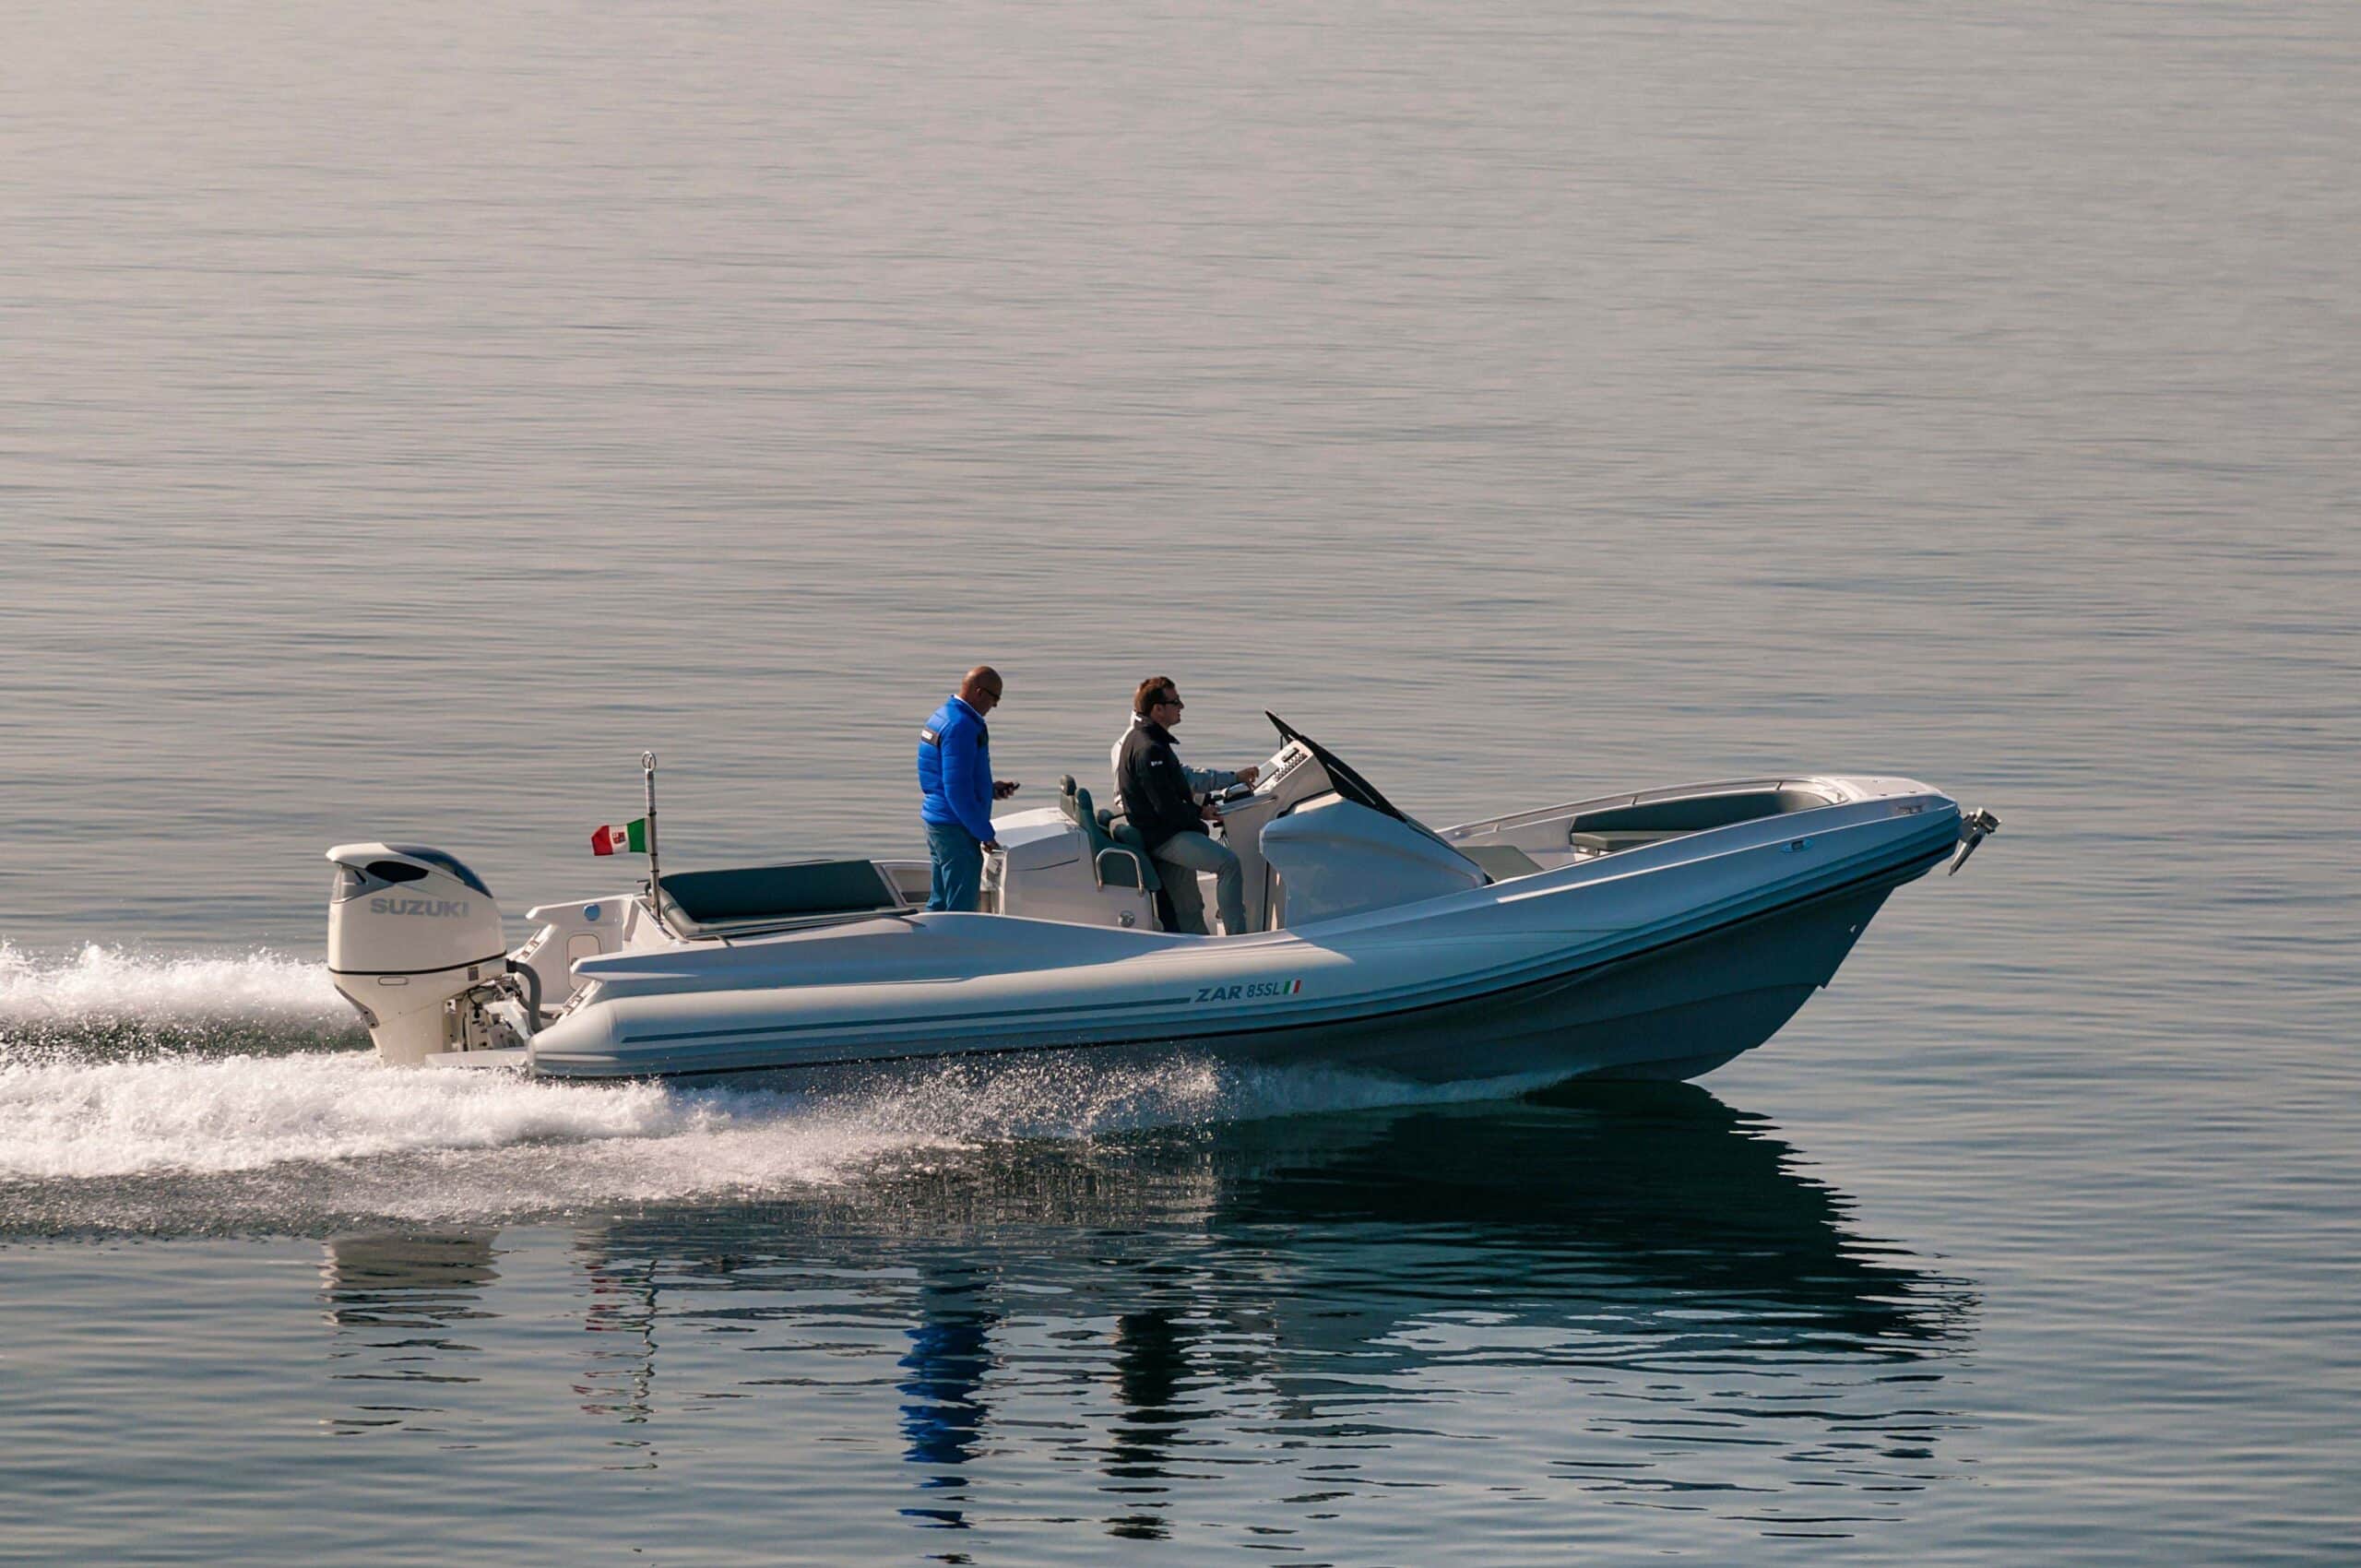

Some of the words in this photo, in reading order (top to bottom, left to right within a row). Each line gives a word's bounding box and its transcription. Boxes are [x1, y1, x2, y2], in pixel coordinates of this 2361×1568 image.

[370, 897, 469, 917] SUZUKI
[1194, 985, 1242, 1003] ZAR
[1246, 981, 1280, 998] 85SL
